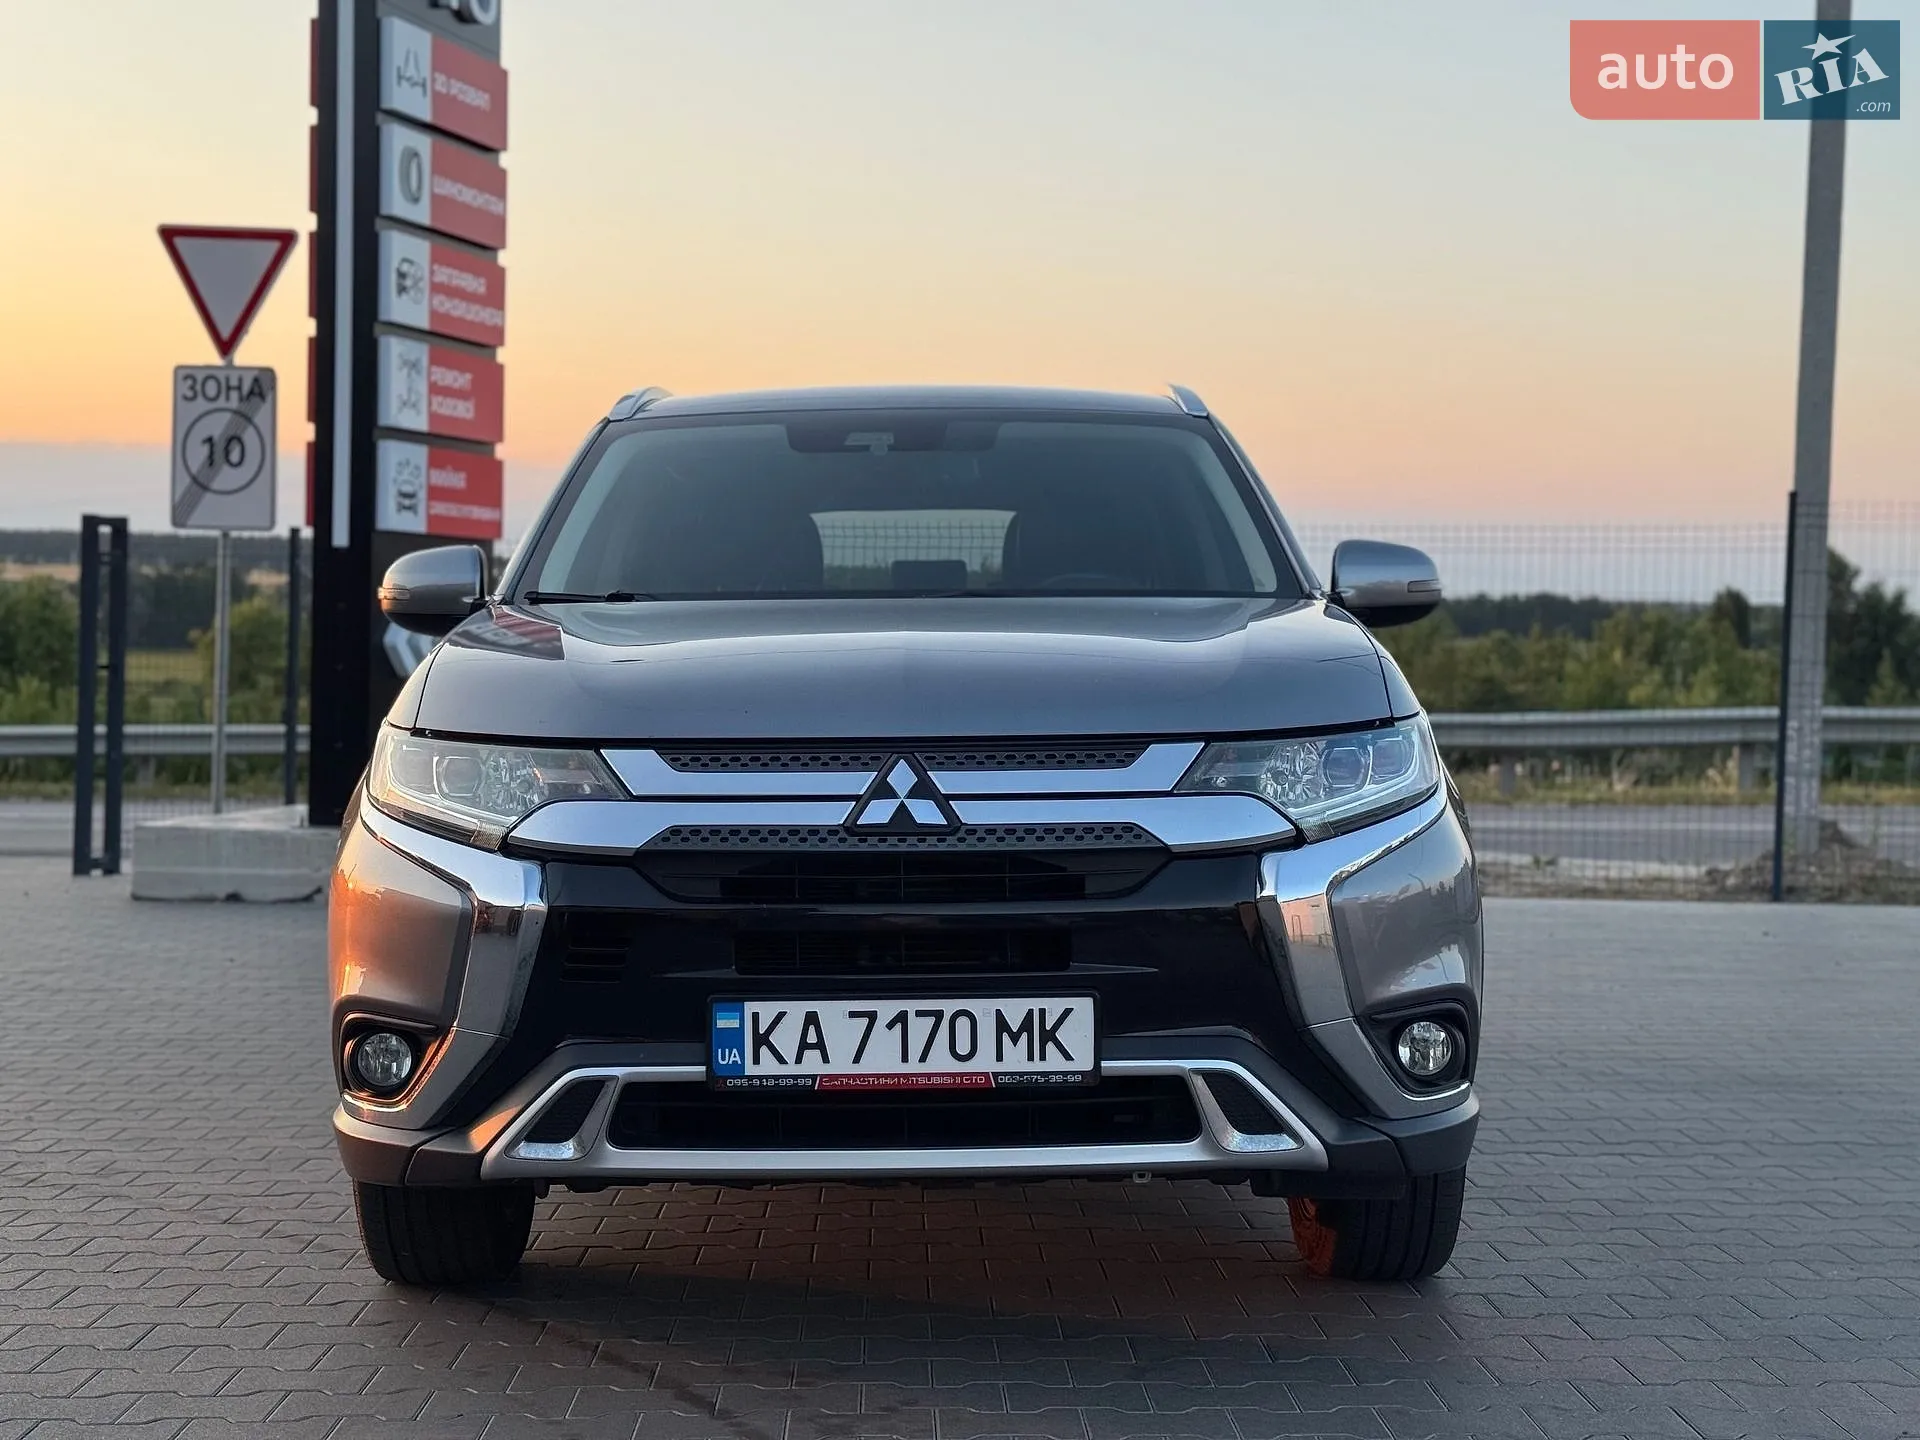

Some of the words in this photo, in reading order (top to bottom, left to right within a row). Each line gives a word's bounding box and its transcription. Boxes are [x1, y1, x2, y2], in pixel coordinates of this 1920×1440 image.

[181, 374, 266, 403] ЗОНА
[201, 436, 245, 468] 10
[751, 1011, 830, 1066] KA
[848, 1008, 979, 1064] 7170
[995, 1007, 1075, 1062] MK
[717, 1048, 742, 1065] UA
[900, 1076, 960, 1085] MITSUBISHI
